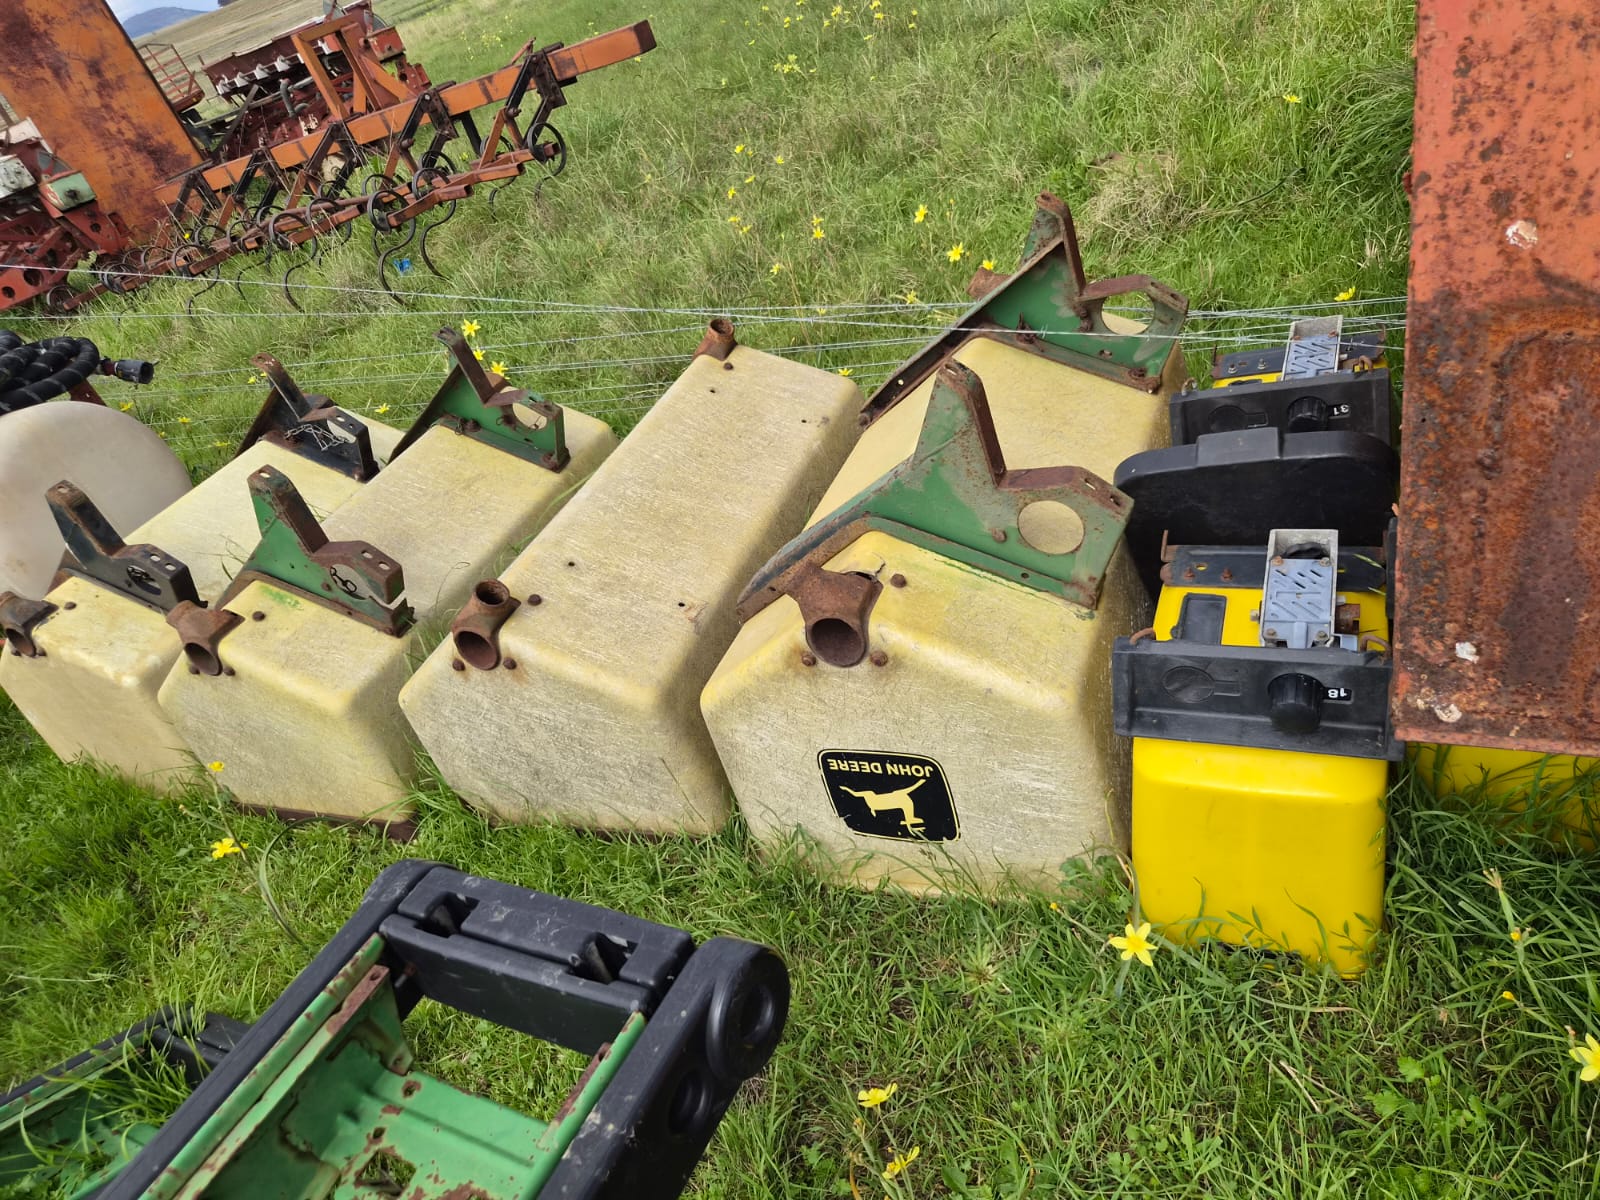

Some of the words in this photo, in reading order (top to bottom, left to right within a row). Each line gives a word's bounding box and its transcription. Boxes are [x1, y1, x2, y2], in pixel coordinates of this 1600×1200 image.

[1333, 404, 1349, 416] 31
[1328, 687, 1347, 698] 18
[826, 758, 883, 774] DEERE
[886, 762, 934, 778] JOHN
